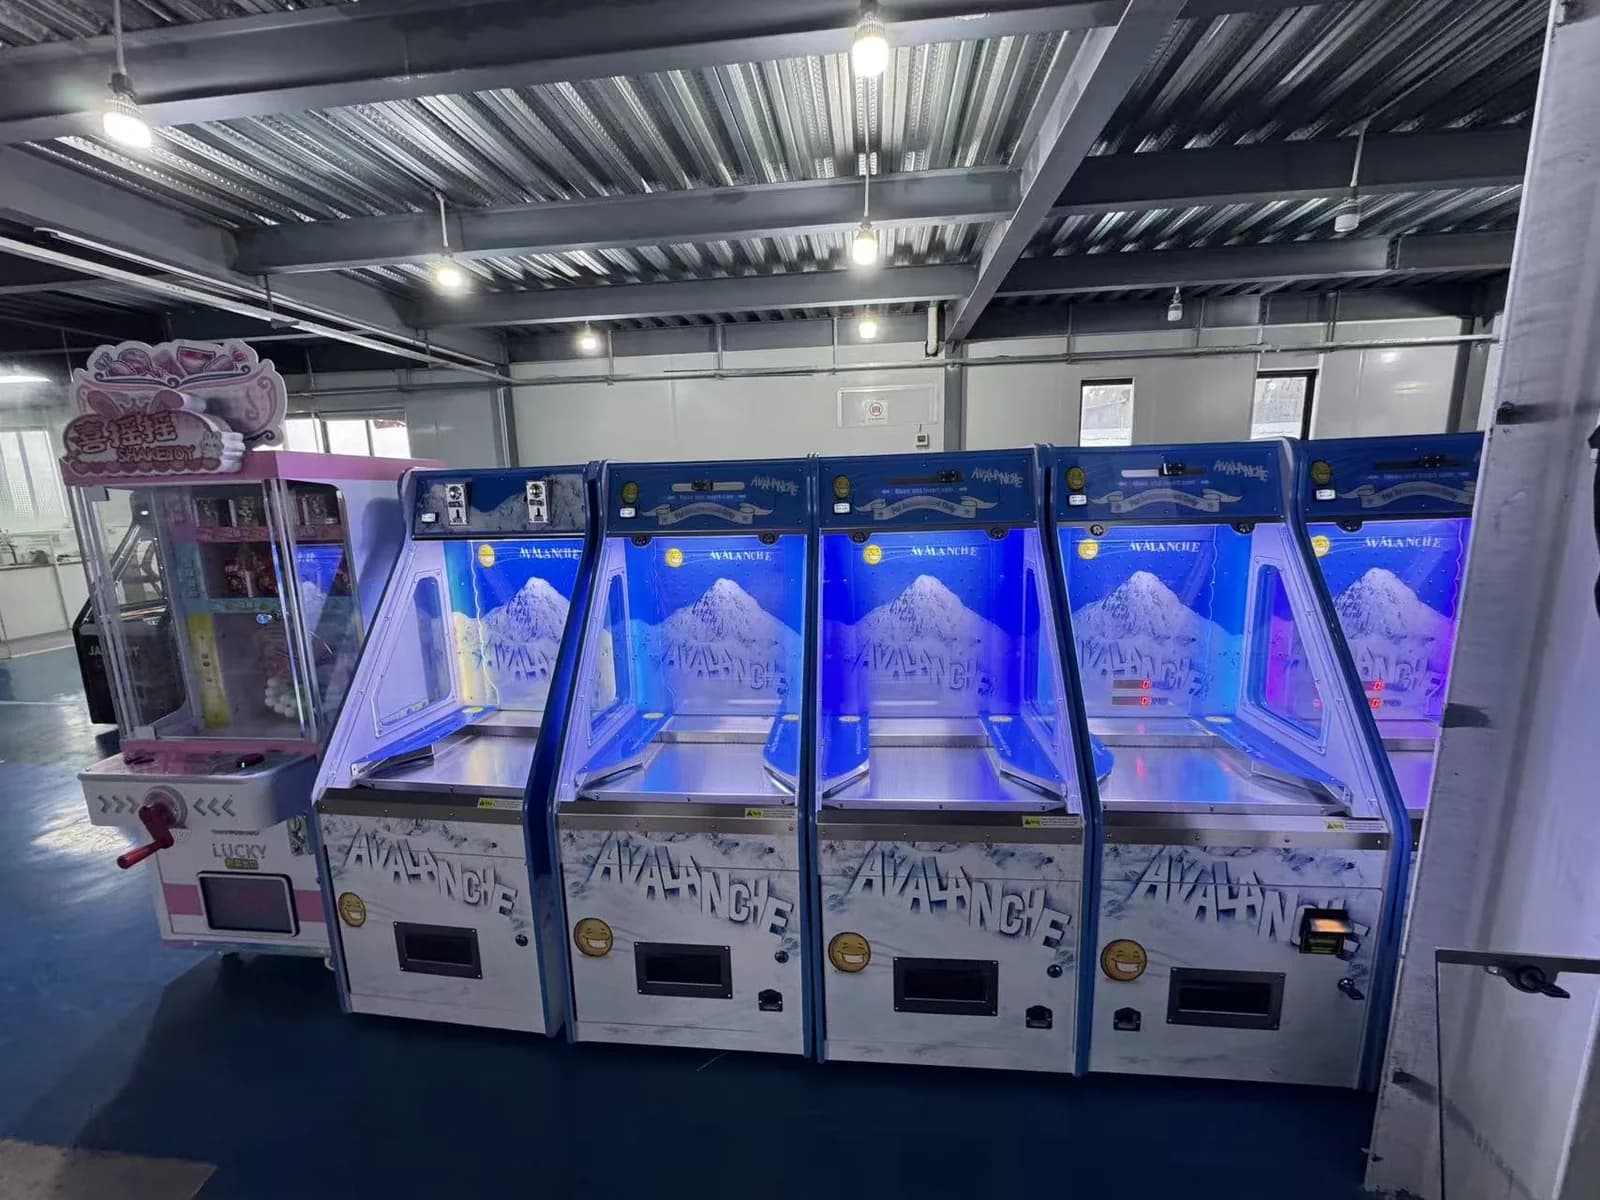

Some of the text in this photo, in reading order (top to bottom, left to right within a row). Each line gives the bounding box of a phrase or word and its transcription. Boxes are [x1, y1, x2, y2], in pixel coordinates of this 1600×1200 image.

[970, 466, 1025, 489] AVALANCHE
[1128, 541, 1201, 553] AVALANCHE
[1363, 536, 1442, 549] AVALANCHE
[519, 546, 581, 561] AVALANCHE
[709, 549, 773, 562] AVALANCHE
[910, 545, 977, 557] AVALANCHE
[211, 843, 267, 860] LUCKY
[342, 826, 518, 918] AVALANCHE
[583, 833, 796, 938] AVALANCHE
[847, 841, 1074, 951] AVALANCHE
